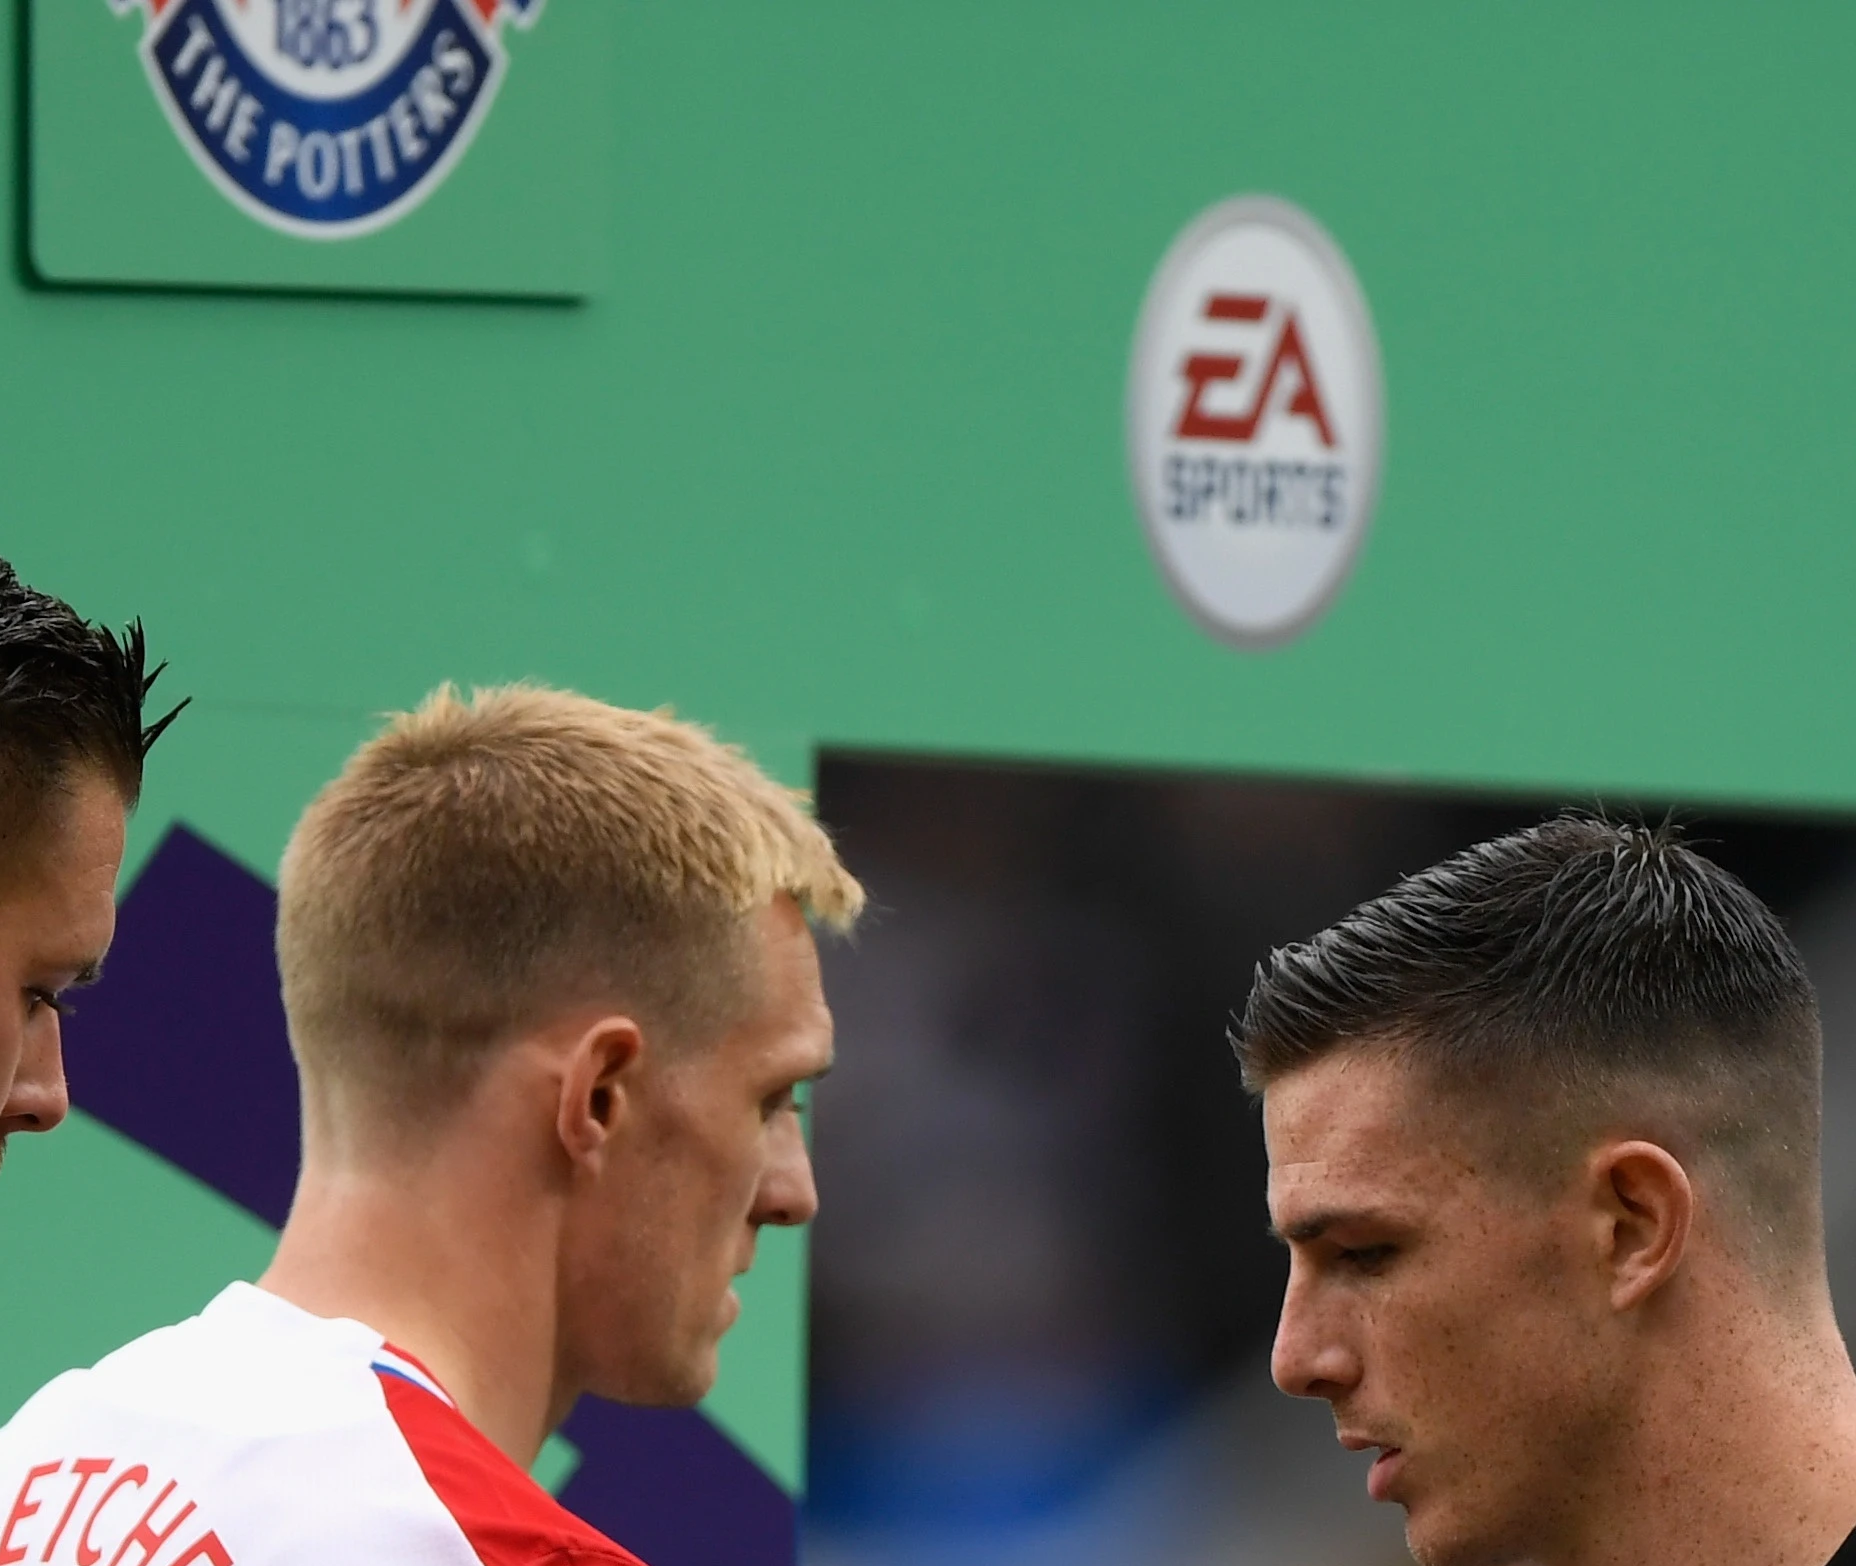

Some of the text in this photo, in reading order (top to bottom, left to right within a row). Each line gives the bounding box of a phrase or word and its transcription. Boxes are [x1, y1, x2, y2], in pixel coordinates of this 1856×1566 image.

[173, 14, 475, 199] THE POTTERS
[1174, 294, 1339, 450] EA
[1164, 454, 1345, 530] SPORTS
